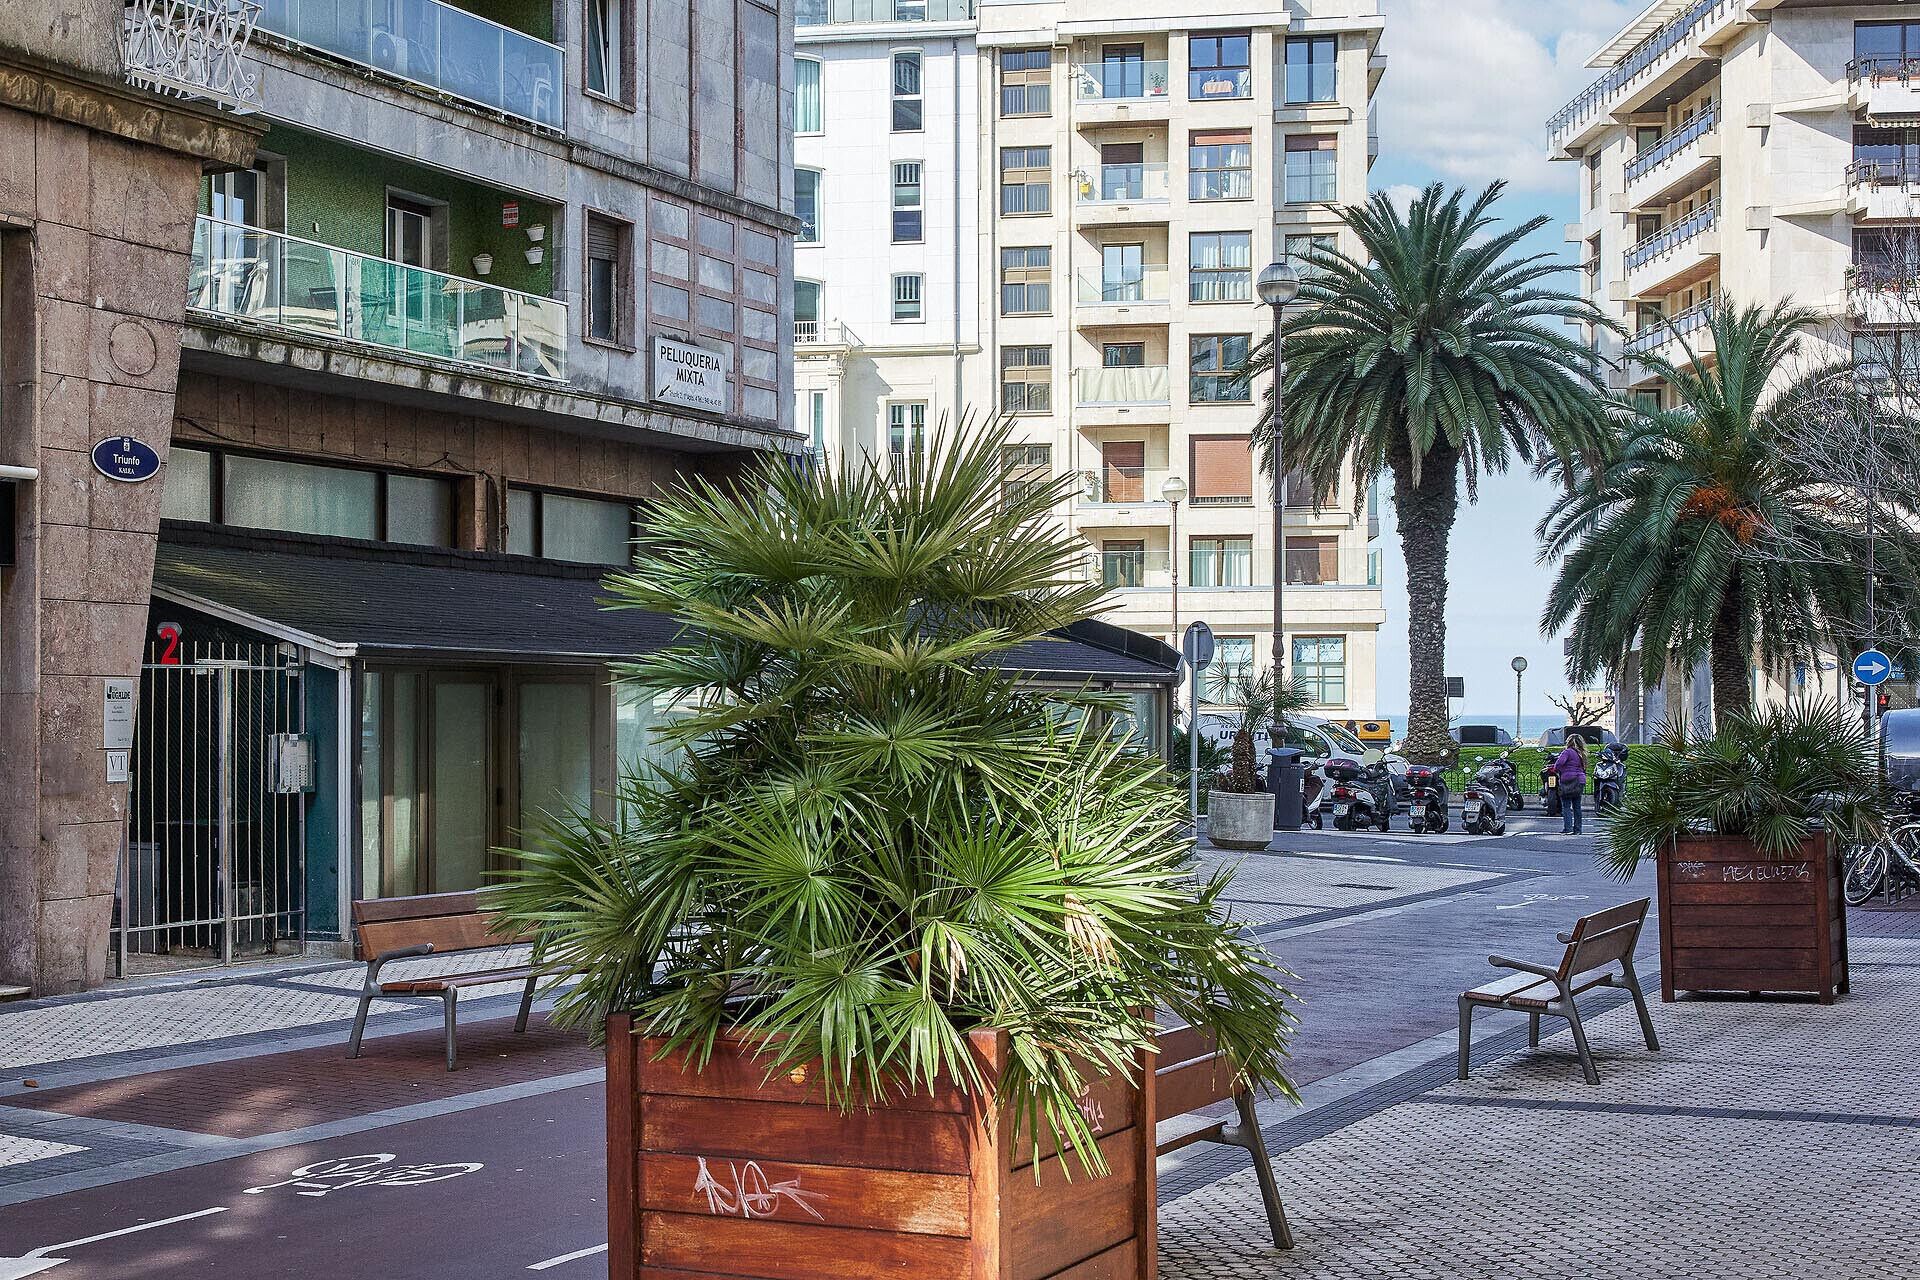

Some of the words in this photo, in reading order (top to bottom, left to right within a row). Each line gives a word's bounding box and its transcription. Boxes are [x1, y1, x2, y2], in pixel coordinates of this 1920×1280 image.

[660, 345, 721, 372] PELUQUERIA
[676, 367, 705, 386] MIXTA
[113, 453, 141, 466] Triunfo
[118, 467, 135, 475] KALEA
[159, 627, 180, 665] 2
[109, 755, 126, 770] VT
